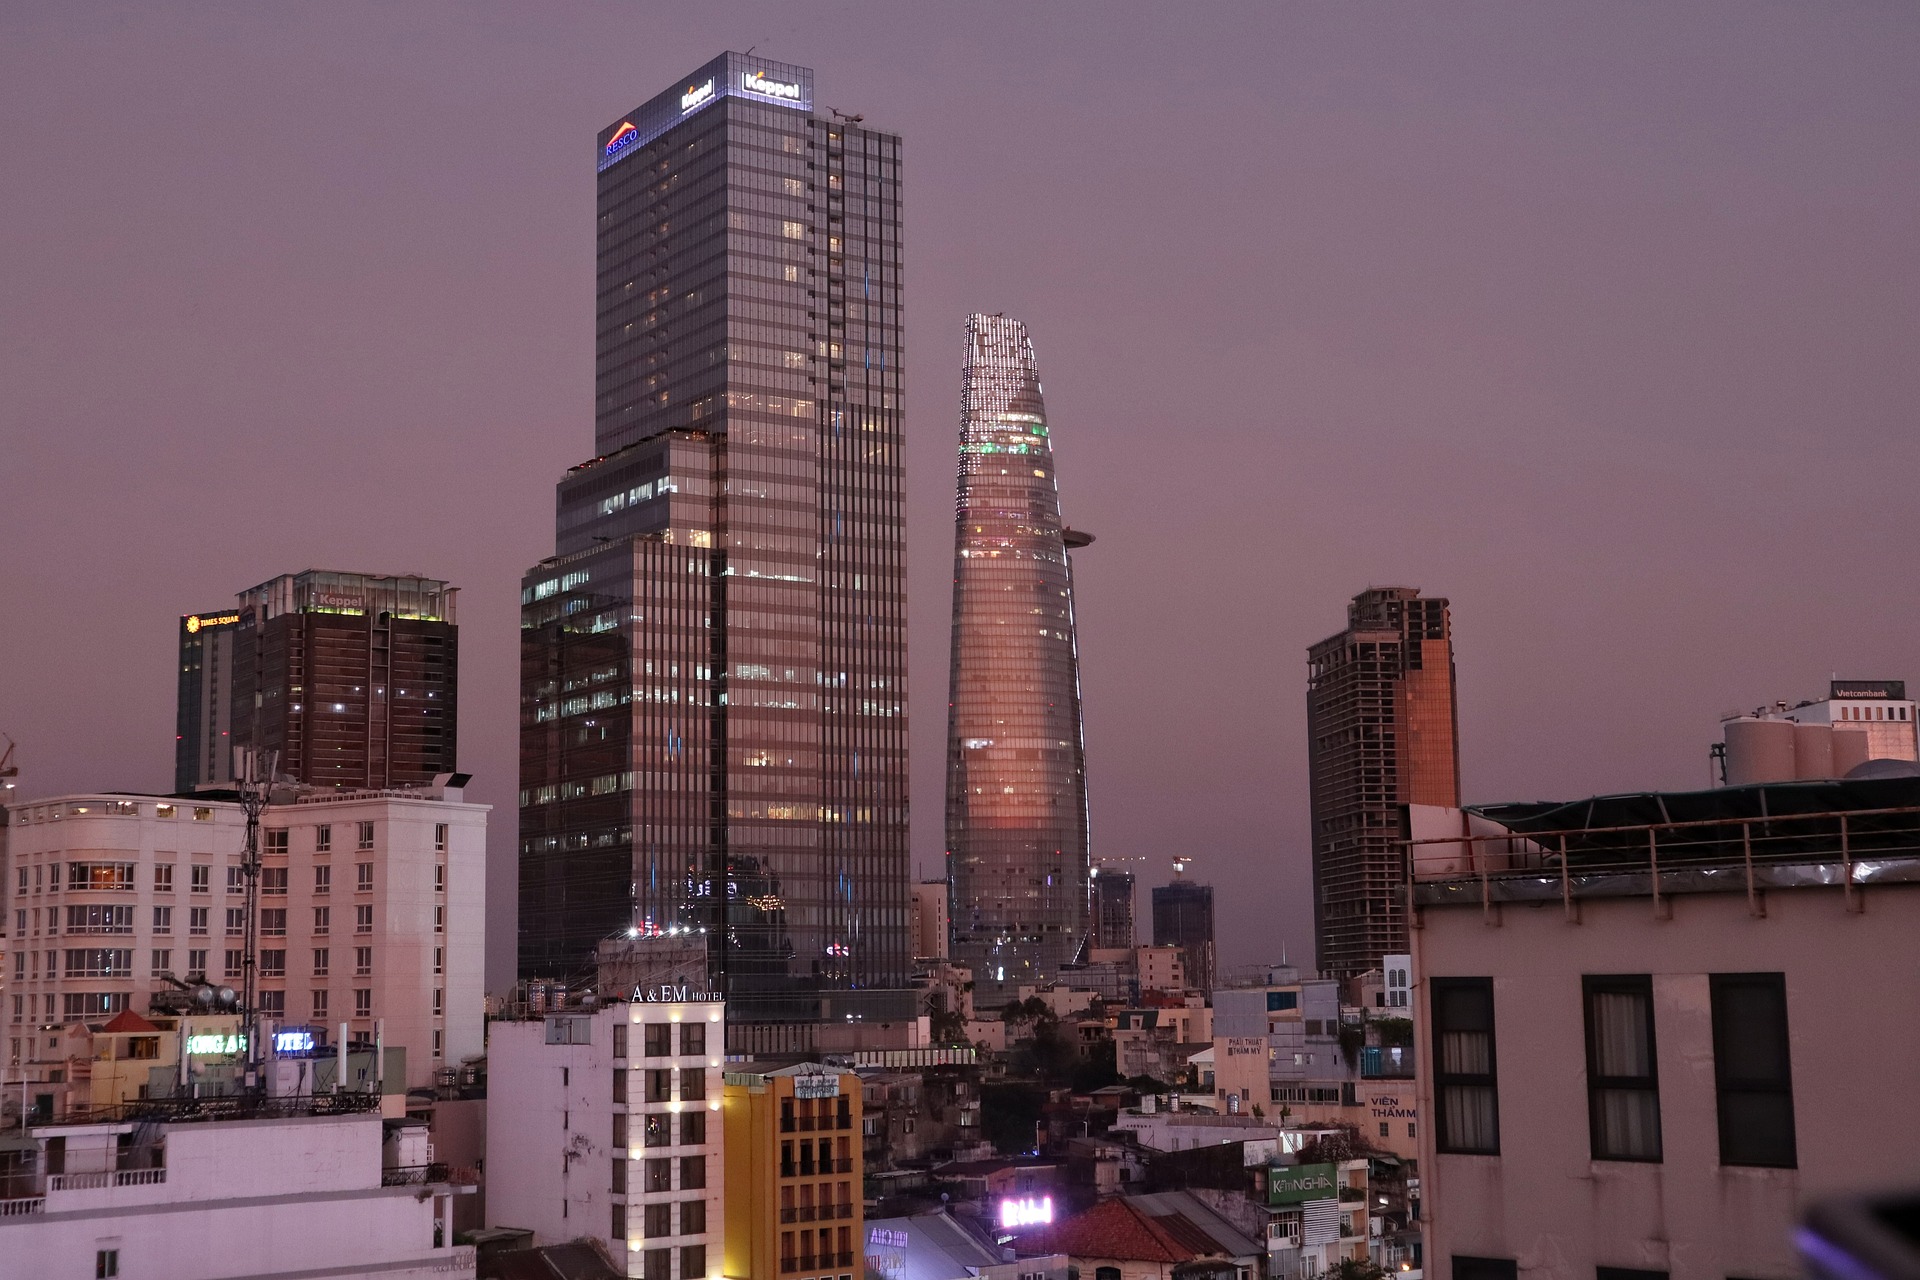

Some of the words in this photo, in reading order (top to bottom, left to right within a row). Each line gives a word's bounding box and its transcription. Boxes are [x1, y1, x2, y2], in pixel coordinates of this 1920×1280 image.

[745, 71, 800, 99] Keppel
[604, 129, 638, 156] RESCO
[319, 594, 362, 608] Keppel
[200, 617, 218, 627] TIMES
[218, 615, 240, 625] SQUAR
[1836, 689, 1888, 698] Vietcombank
[631, 984, 645, 1003] A
[646, 988, 658, 1003] &
[660, 984, 687, 1003] EM
[692, 991, 726, 1002] HOTEL
